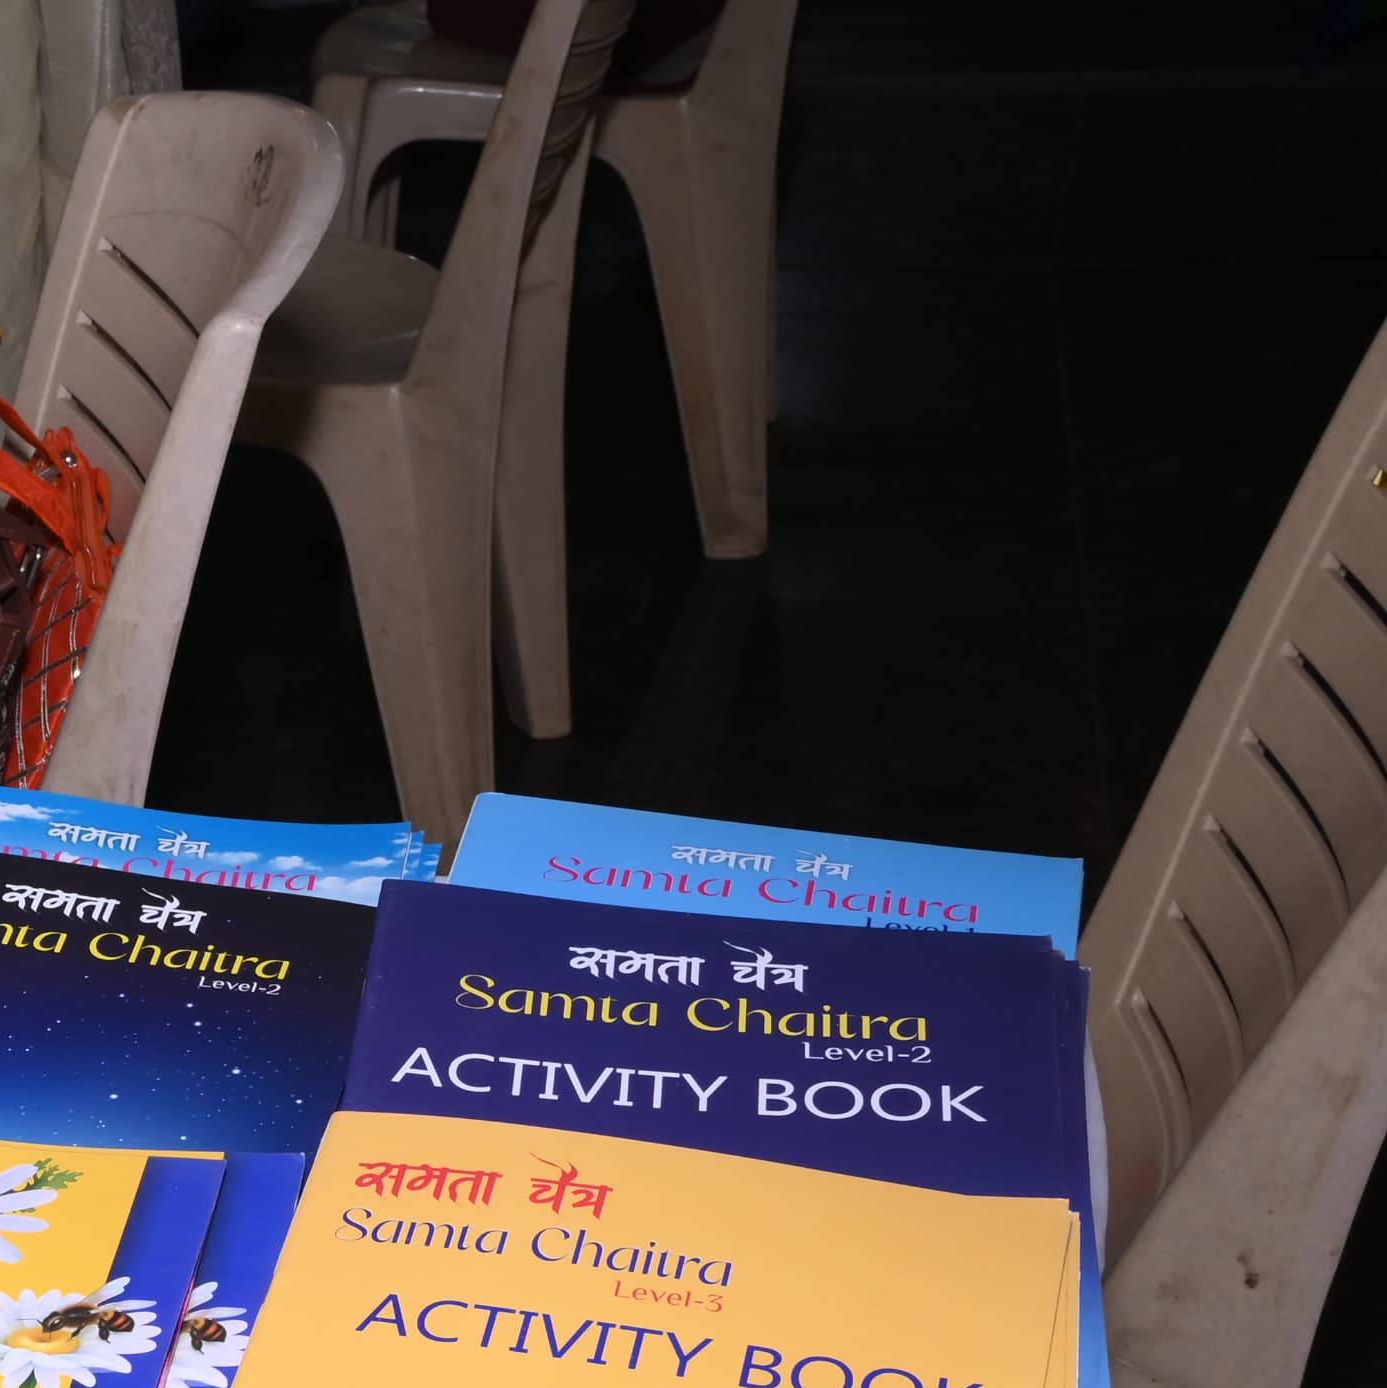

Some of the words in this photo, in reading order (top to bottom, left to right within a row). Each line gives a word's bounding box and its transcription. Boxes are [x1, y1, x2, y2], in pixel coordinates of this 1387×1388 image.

[47, 822, 140, 852] समता
[156, 825, 210, 859] चैत्र
[671, 844, 776, 873] समता
[794, 848, 854, 881] चैत्र
[2, 882, 121, 923] समता
[140, 887, 207, 936] चैत्र
[543, 855, 732, 898] Samta
[758, 877, 979, 924] Chaitra
[89, 932, 291, 981] Chaitra
[569, 944, 705, 987] समता
[722, 940, 809, 994] चैत्र
[198, 976, 281, 996] Level-2
[455, 973, 659, 1028] Samta
[687, 996, 929, 1042] Chaitra
[802, 1040, 932, 1063] Level-2
[391, 1047, 728, 1113] ACTIVITY
[757, 1077, 988, 1124] BOOK
[354, 1161, 503, 1208] समता
[527, 1152, 613, 1221] चैत्र
[334, 1207, 508, 1256] Samta
[531, 1227, 733, 1287] Chaitra
[614, 1280, 725, 1313] Level-3
[356, 1292, 714, 1379] ACTIVITY
